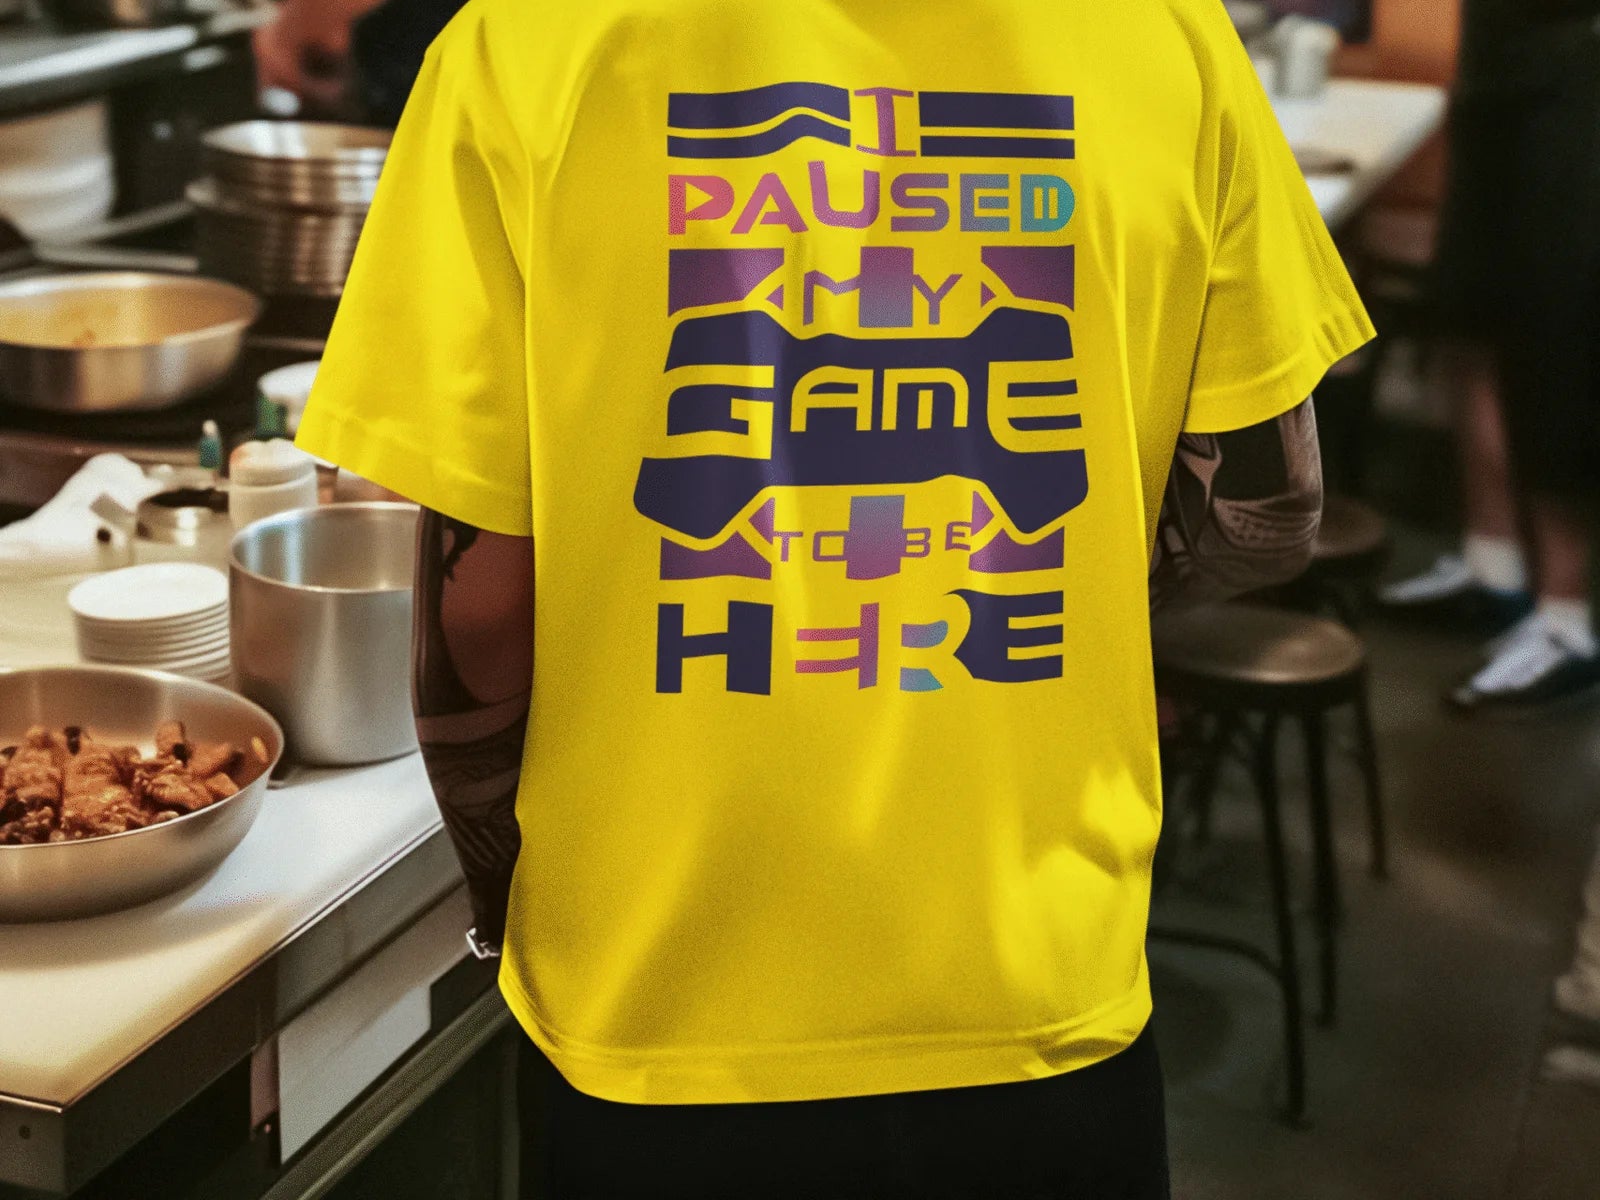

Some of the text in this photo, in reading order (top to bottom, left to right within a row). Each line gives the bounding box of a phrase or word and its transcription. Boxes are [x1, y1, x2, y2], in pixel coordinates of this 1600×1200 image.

[854, 87, 917, 157] I
[668, 160, 1076, 235] PAUSED
[803, 269, 963, 325] MY
[662, 358, 1083, 460] GAME
[772, 521, 972, 562] TO BE
[656, 589, 1064, 696] HERE
